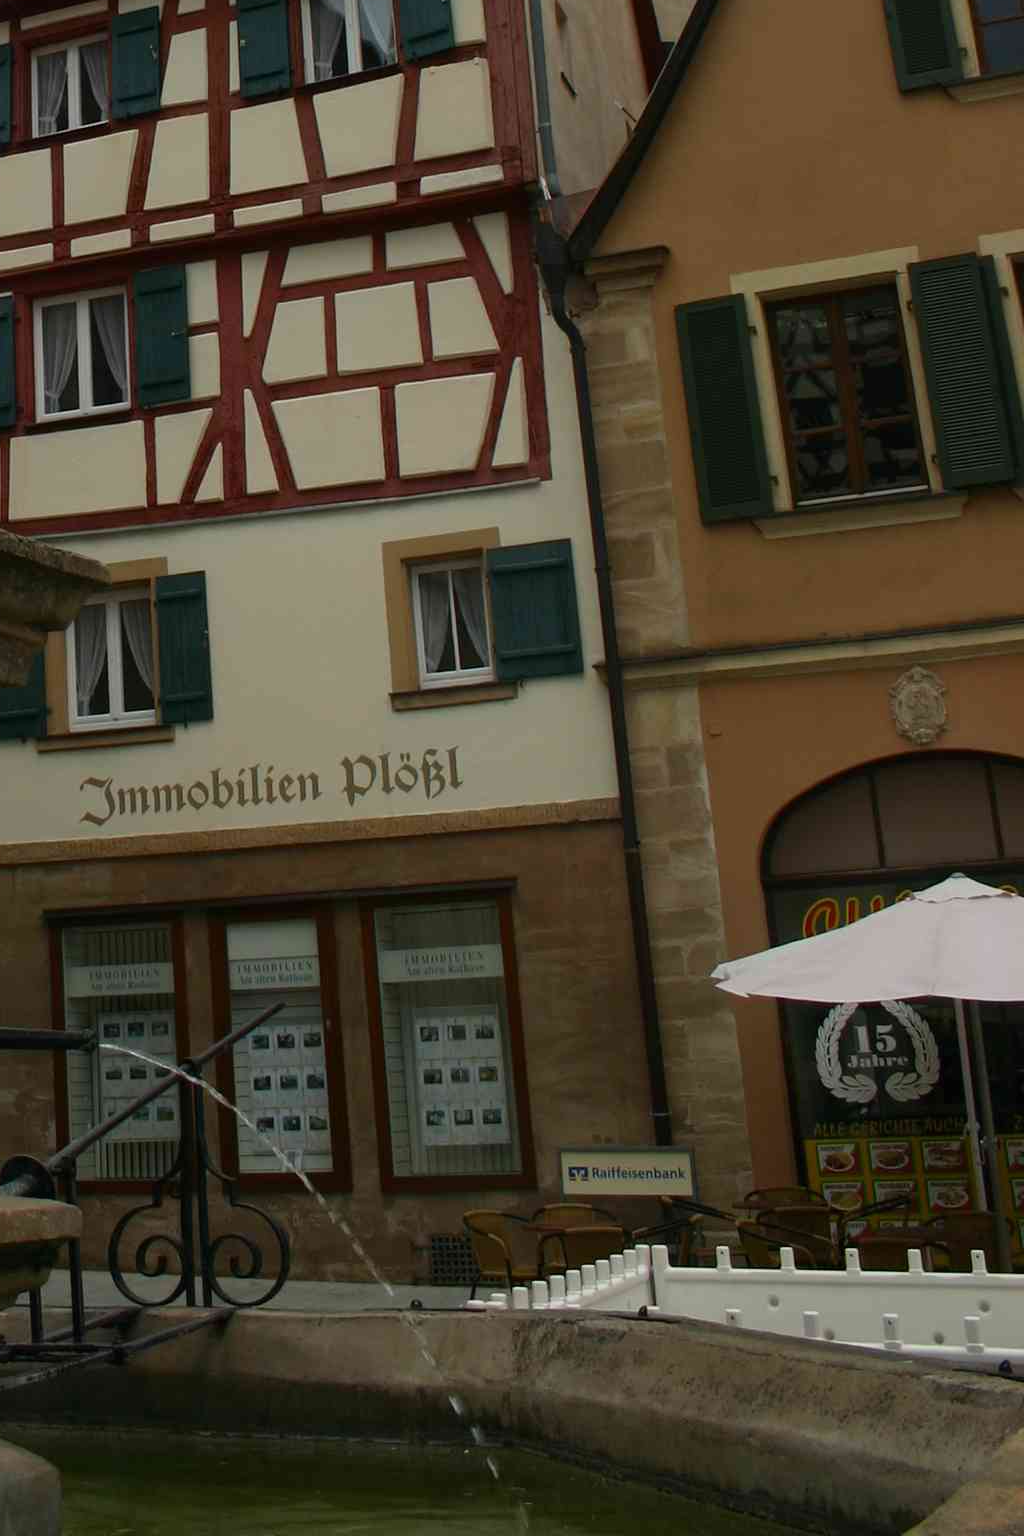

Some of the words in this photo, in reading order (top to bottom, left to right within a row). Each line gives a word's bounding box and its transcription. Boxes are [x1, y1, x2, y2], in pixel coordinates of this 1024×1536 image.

[78, 763, 323, 827] Immobilien
[340, 745, 464, 807] Plößl
[404, 950, 485, 965] IMMOBILIEN
[88, 967, 161, 981] IMMOBILIEN
[236, 960, 313, 975] IMMOBILIEN
[853, 1024, 897, 1053] 15
[846, 1053, 909, 1070] Jahre
[592, 1166, 686, 1179] Raiffeisenbank
